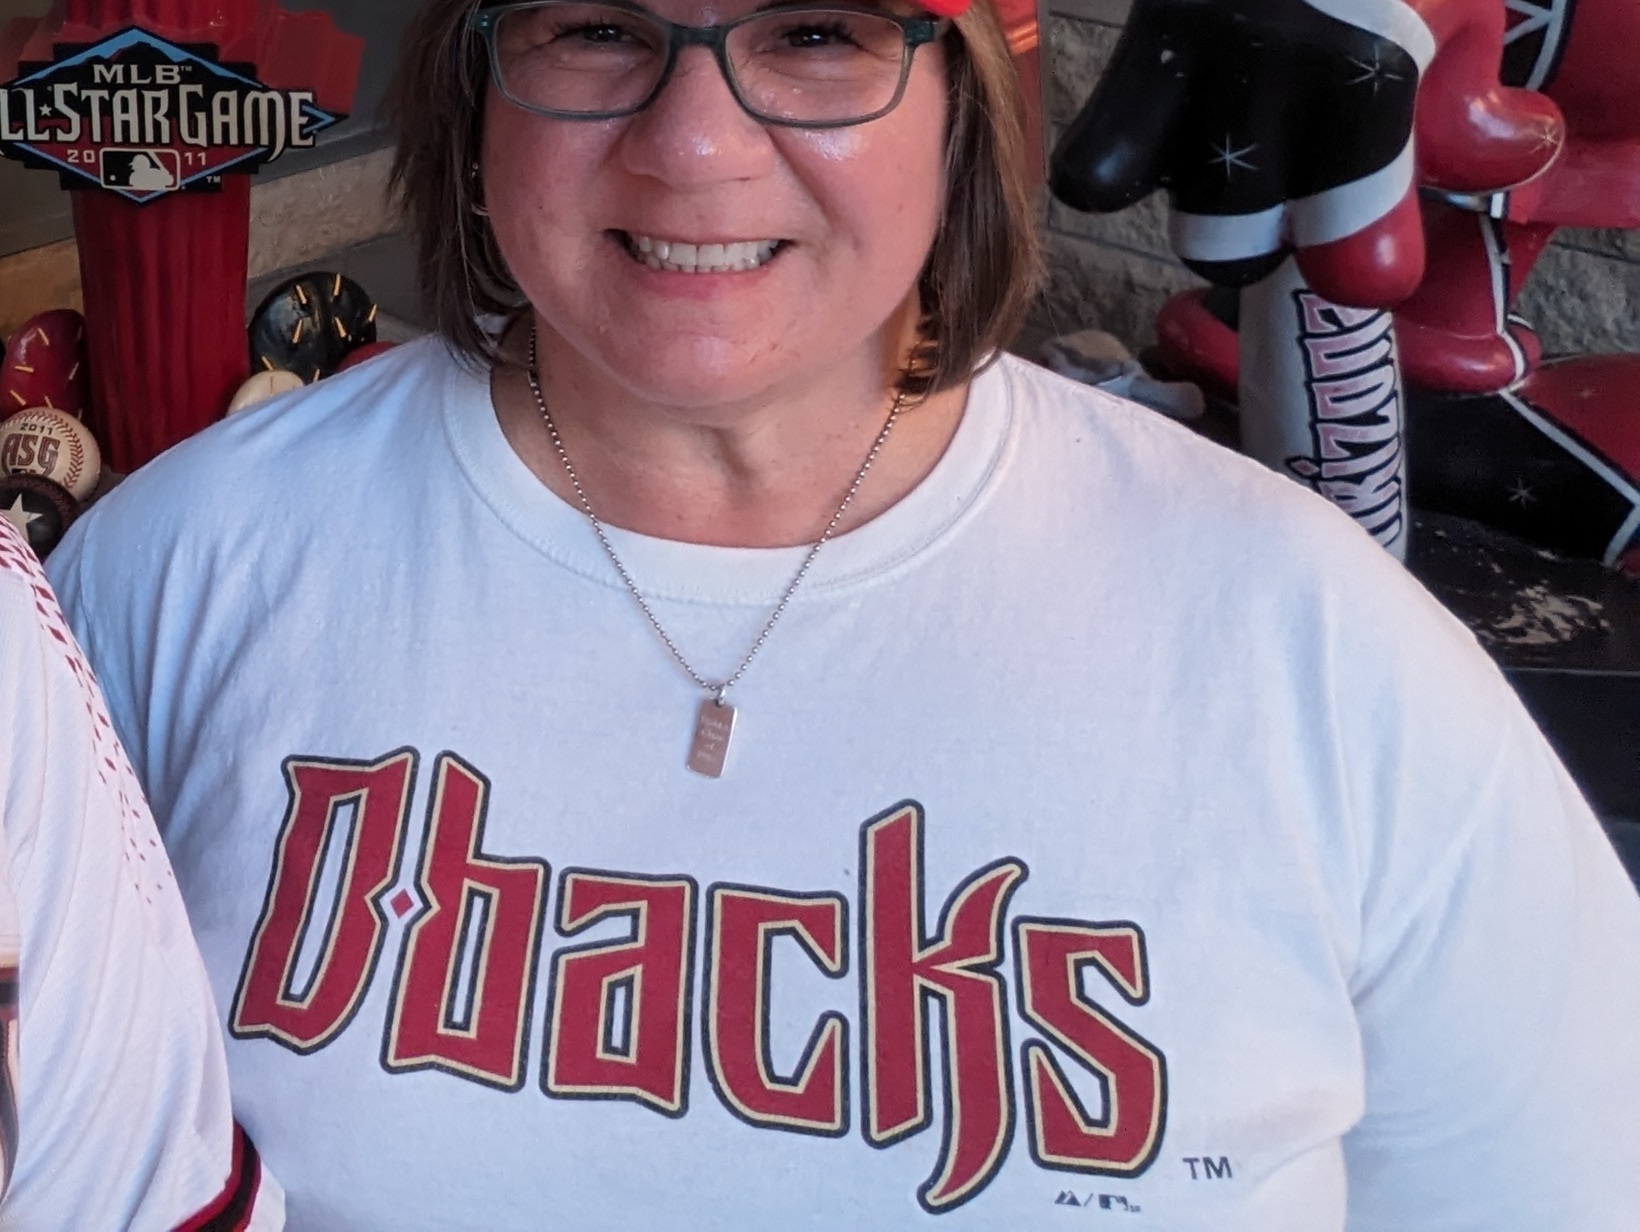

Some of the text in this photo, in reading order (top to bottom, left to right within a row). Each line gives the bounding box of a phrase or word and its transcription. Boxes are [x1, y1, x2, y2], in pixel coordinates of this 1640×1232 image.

[93, 64, 182, 84] MLB
[178, 83, 315, 161] GAME
[19, 422, 54, 436] 2011
[1, 433, 61, 477] ASG
[1182, 1156, 1234, 1180] TM
